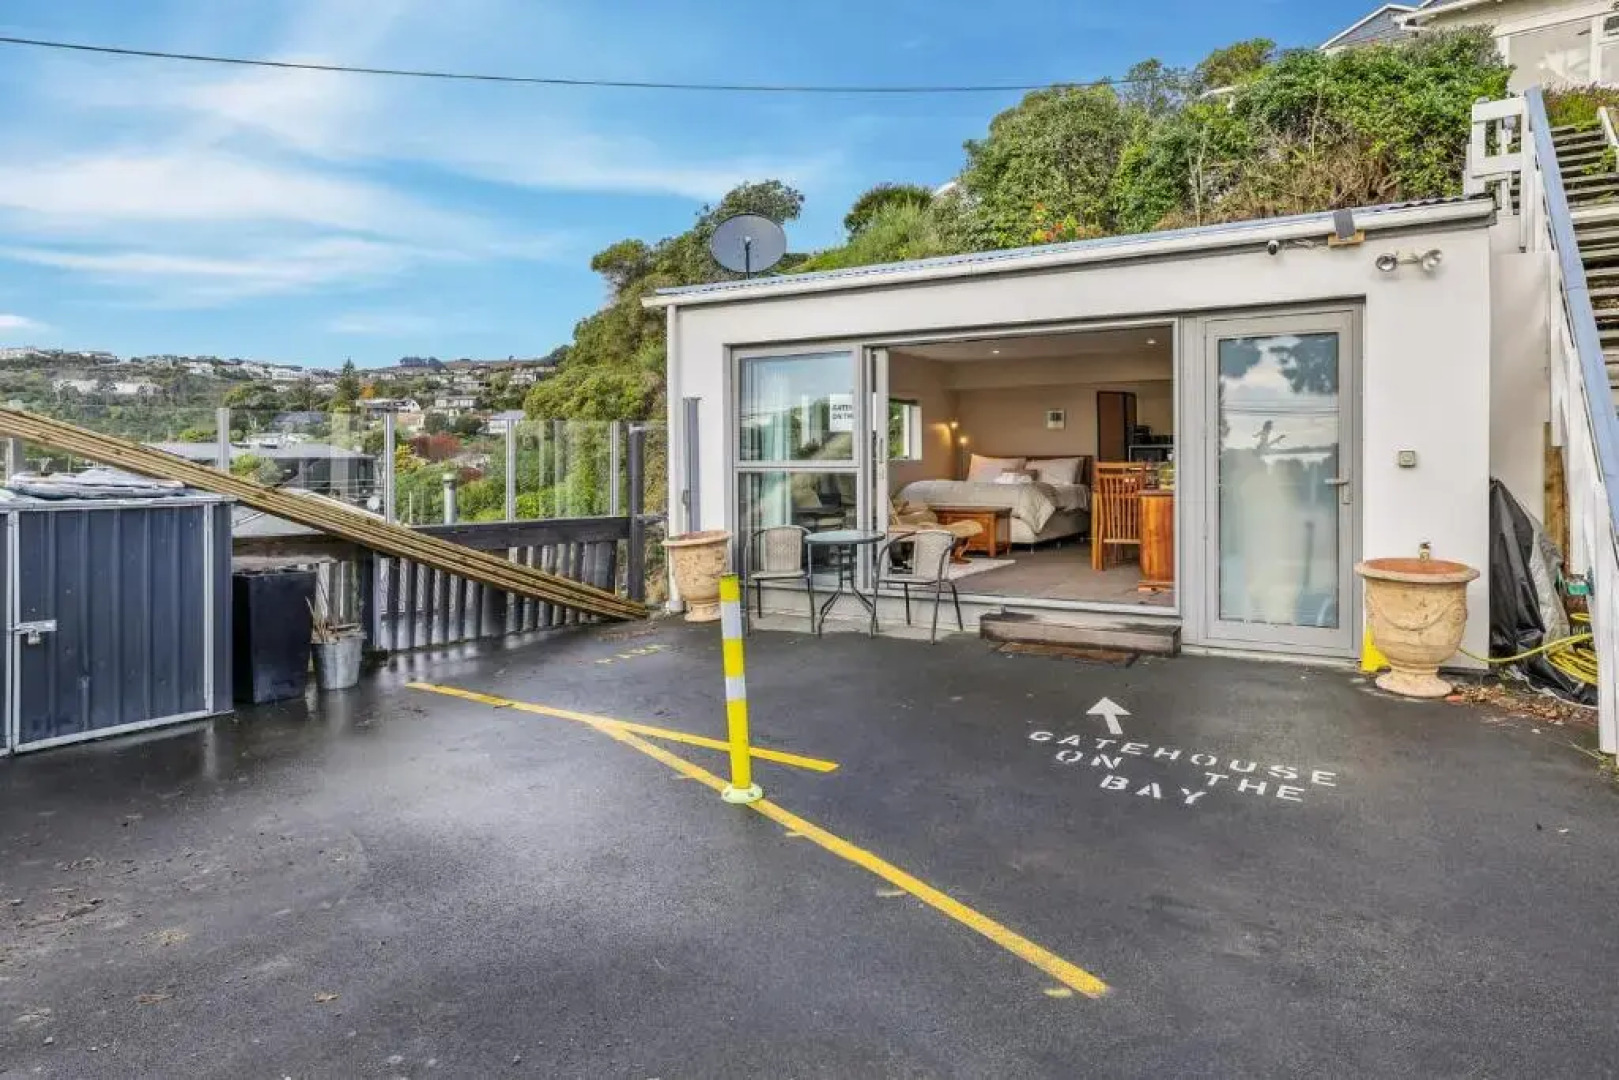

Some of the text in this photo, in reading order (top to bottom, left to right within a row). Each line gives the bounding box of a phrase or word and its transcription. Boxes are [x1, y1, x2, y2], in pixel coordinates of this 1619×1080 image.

[1028, 731, 1337, 787] GATEHOUSE
[1055, 750, 1305, 802] ON THE
[1100, 774, 1207, 805] BAY
